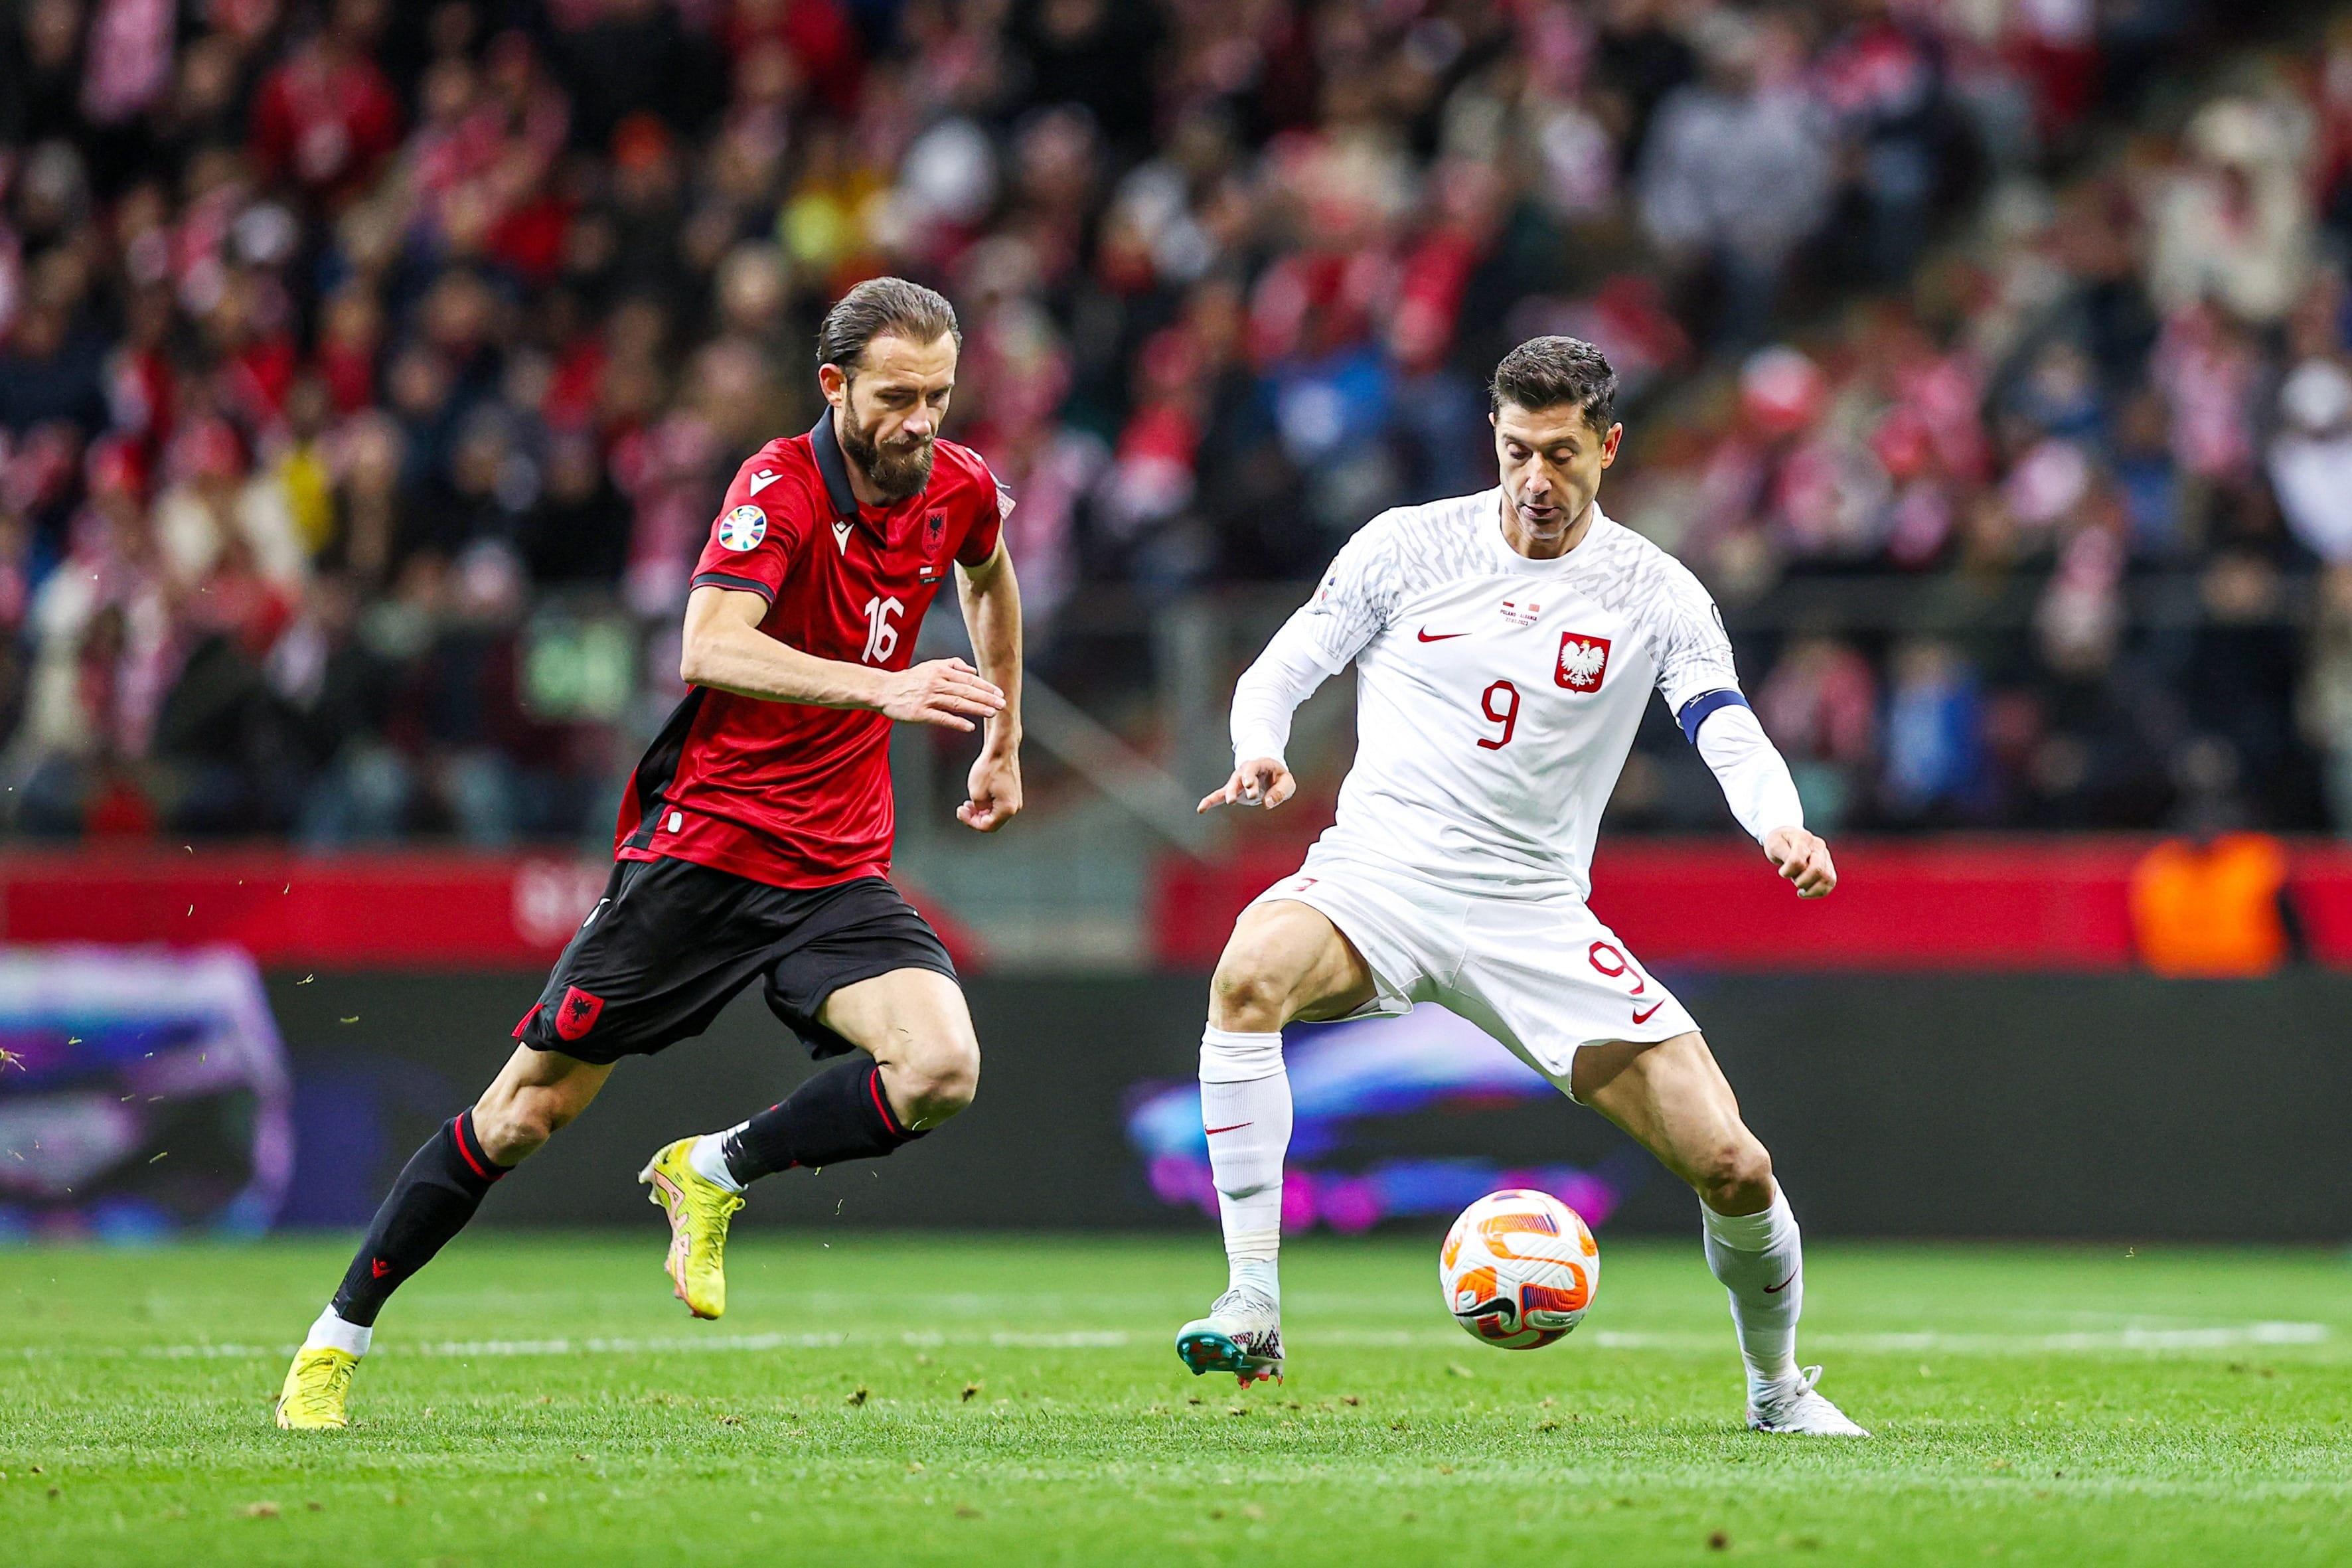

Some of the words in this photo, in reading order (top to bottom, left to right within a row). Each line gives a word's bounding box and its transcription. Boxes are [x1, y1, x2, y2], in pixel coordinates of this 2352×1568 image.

[862, 596, 904, 663] 16
[1477, 680, 1520, 750] 9
[1589, 941, 1644, 995] 9
